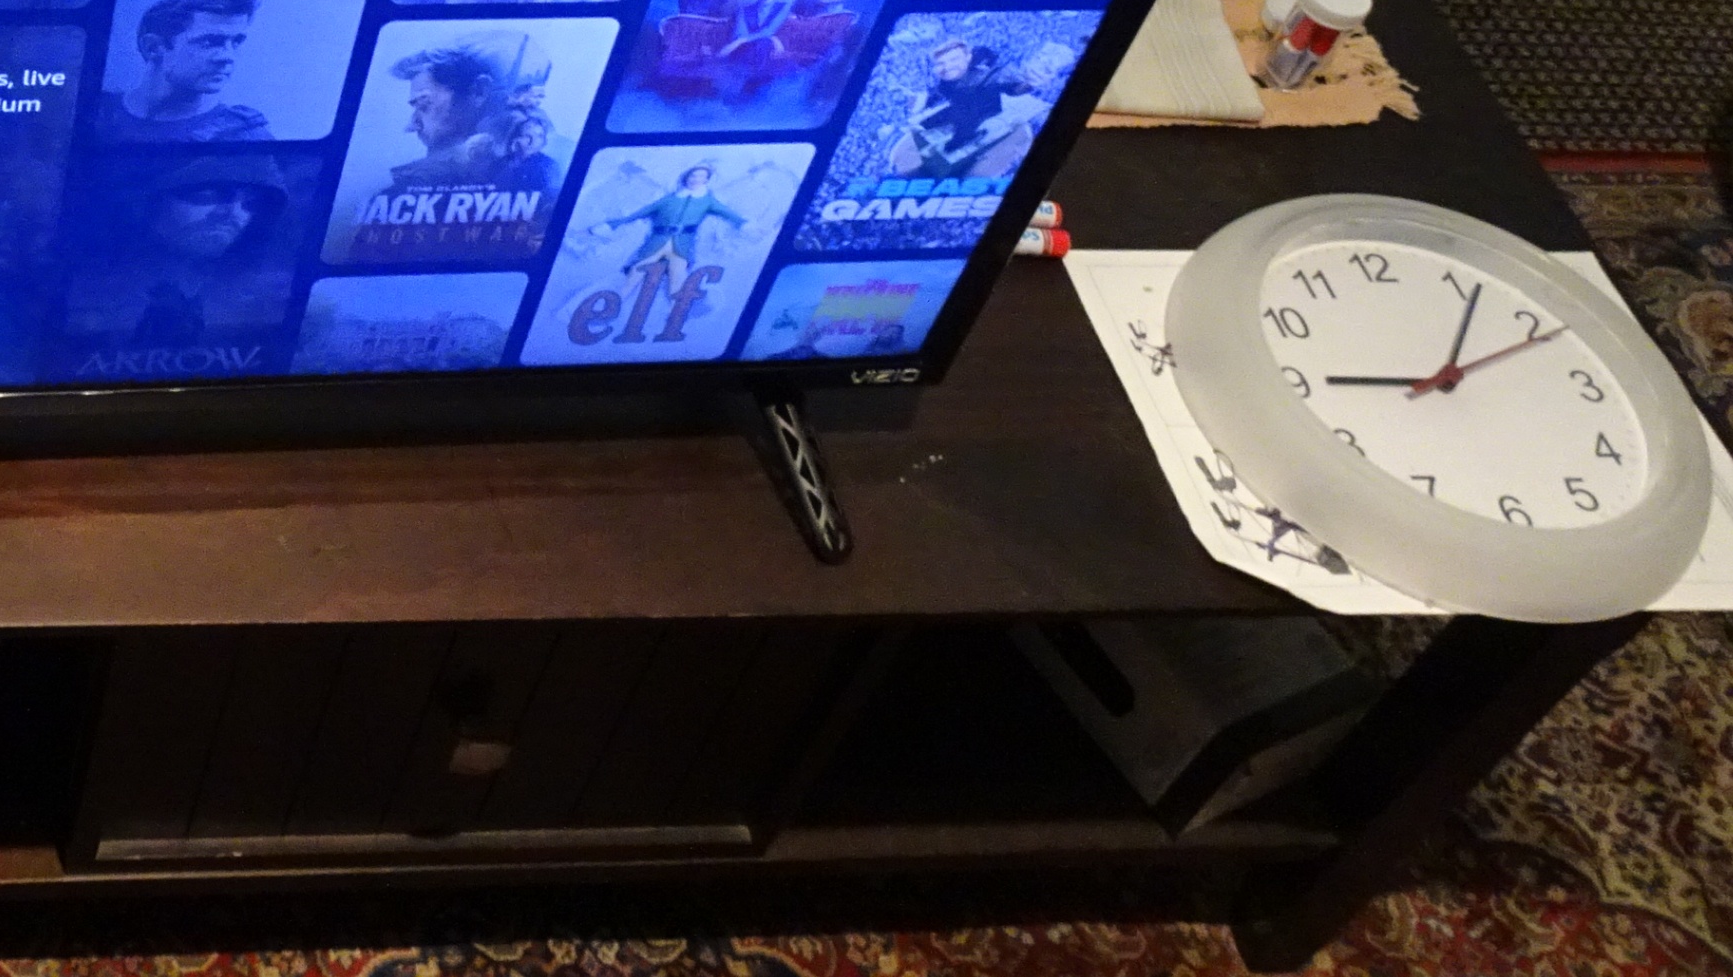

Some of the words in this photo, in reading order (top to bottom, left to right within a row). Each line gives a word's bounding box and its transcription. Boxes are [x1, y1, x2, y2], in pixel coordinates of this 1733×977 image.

[23, 69, 65, 87] live
[876, 177, 1010, 197] BEAST
[444, 191, 541, 223] RYAN
[821, 195, 1003, 221] GAMES
[1293, 269, 1337, 299] 11
[1349, 252, 1399, 284] 12
[1441, 270, 1468, 301] 1
[568, 258, 724, 346] elf
[1264, 306, 1310, 338] 10
[1514, 310, 1542, 341] 2
[75, 342, 264, 375] ARROW
[851, 368, 921, 385] VIZIO
[1280, 367, 1311, 400] 9
[1569, 369, 1604, 403] 3
[1594, 432, 1622, 466] 4
[1564, 477, 1599, 512] 5
[1498, 496, 1533, 527] 6
